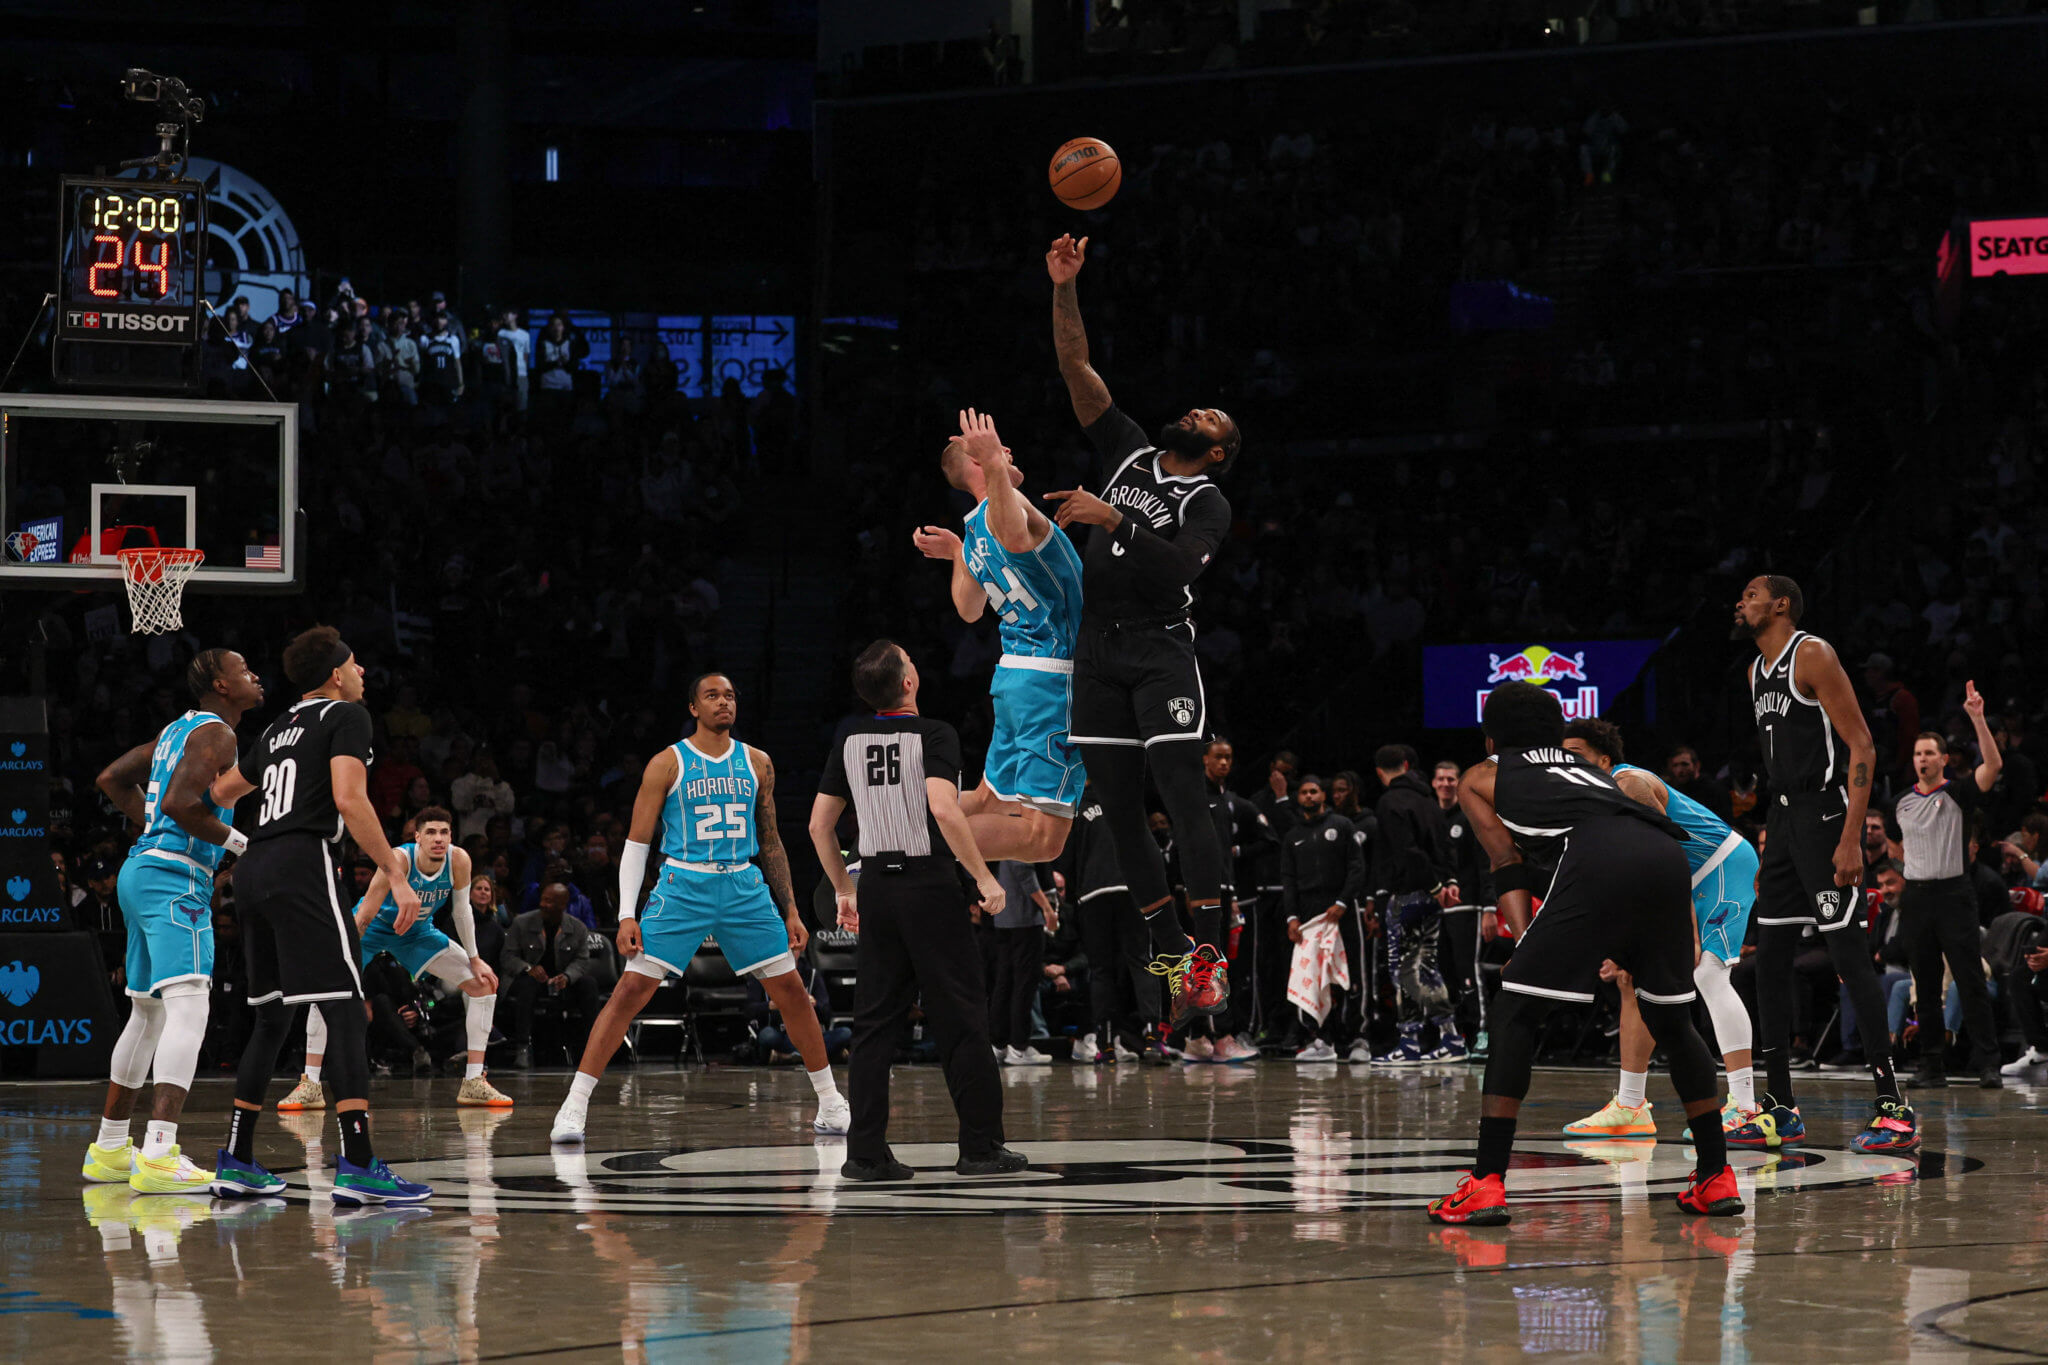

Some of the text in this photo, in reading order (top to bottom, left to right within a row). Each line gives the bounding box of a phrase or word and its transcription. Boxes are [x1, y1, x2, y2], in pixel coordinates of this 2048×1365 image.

[94, 195, 180, 233] 12:00
[88, 234, 169, 297] 24
[101, 312, 189, 332] TISSOT
[1110, 485, 1173, 529] BROOKLYN
[1170, 699, 1194, 712] NETS
[866, 743, 901, 787] 26
[1521, 747, 1576, 764] IRVING
[258, 757, 297, 827] 30
[686, 776, 752, 800] HORNETS
[1545, 765, 1614, 790] 11
[694, 802, 748, 841] 25
[0, 907, 61, 923] RCLAYS
